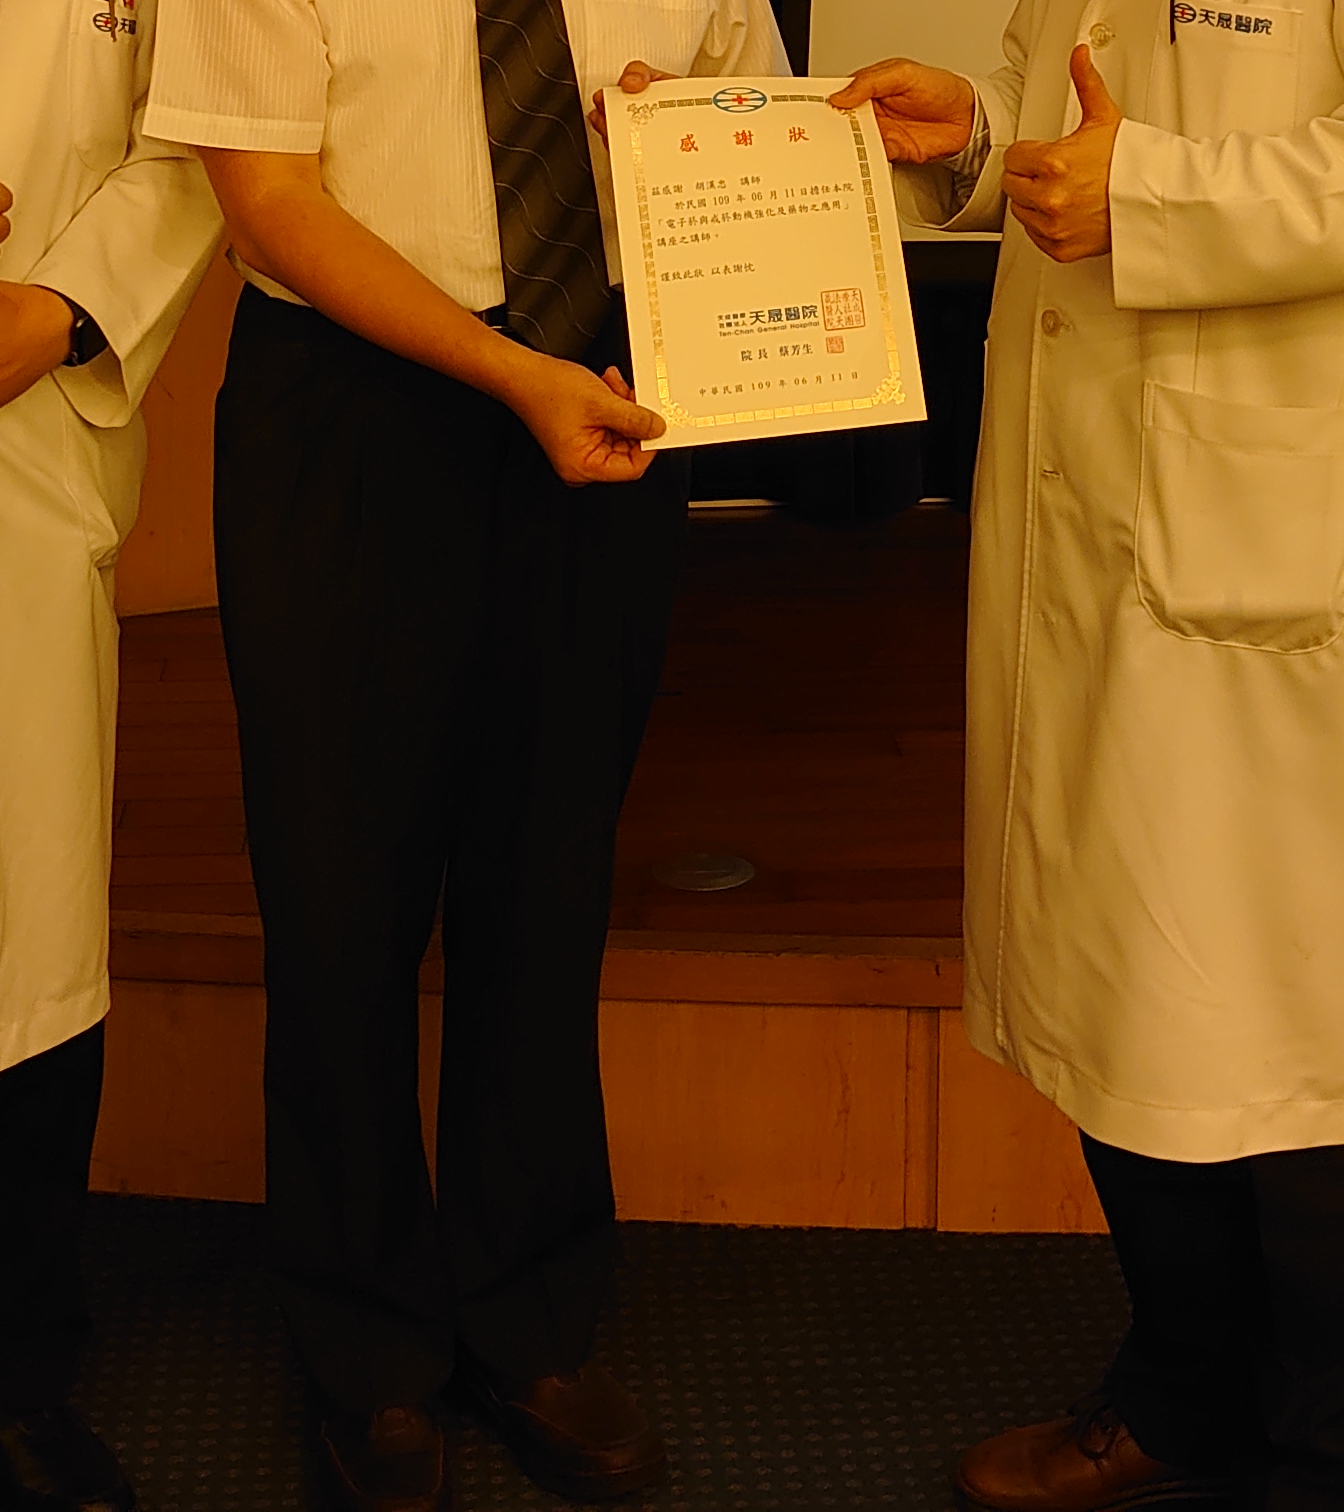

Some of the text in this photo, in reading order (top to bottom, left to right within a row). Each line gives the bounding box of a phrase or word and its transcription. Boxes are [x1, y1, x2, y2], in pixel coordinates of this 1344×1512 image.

[1198, 8, 1273, 36] 天晟醫院
[680, 126, 810, 153] 感謝狀
[713, 195, 730, 206] 109
[749, 304, 819, 326] 天晟醫院
[757, 323, 787, 333] General
